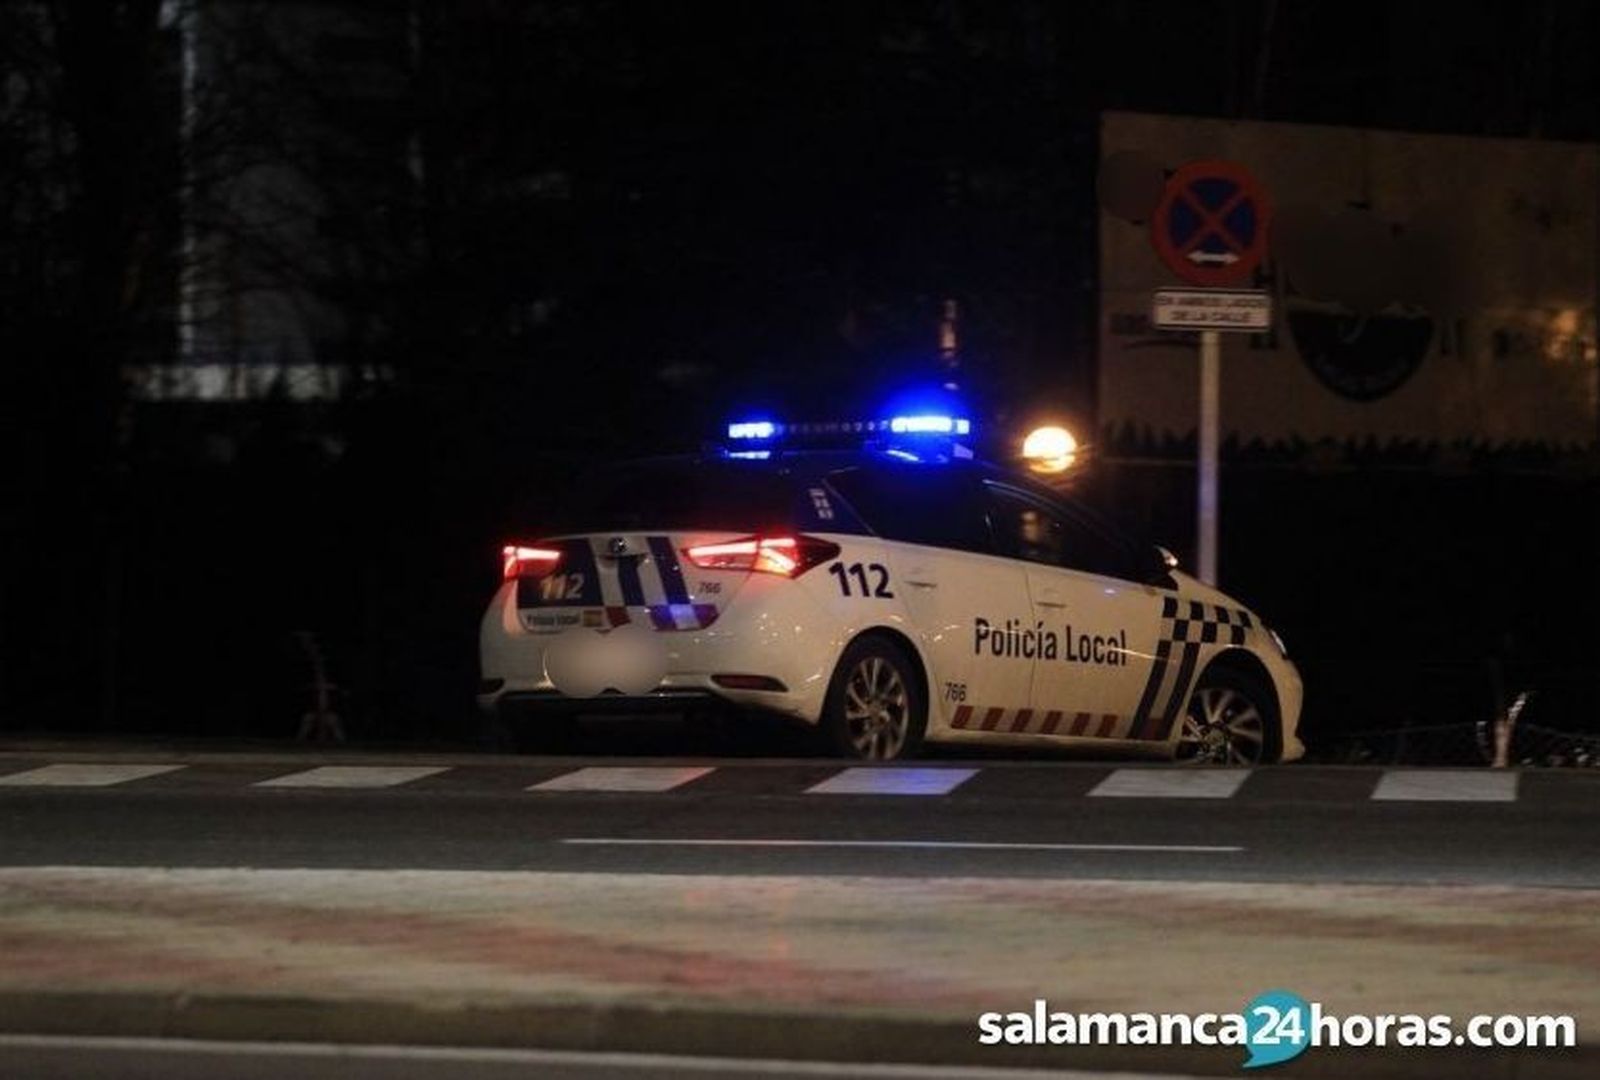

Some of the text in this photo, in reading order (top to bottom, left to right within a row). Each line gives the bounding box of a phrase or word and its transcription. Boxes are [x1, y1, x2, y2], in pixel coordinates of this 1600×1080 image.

[540, 573, 585, 600] 112
[829, 561, 895, 600] 112
[974, 616, 1127, 667] Policía Local
[944, 681, 968, 702] 766
